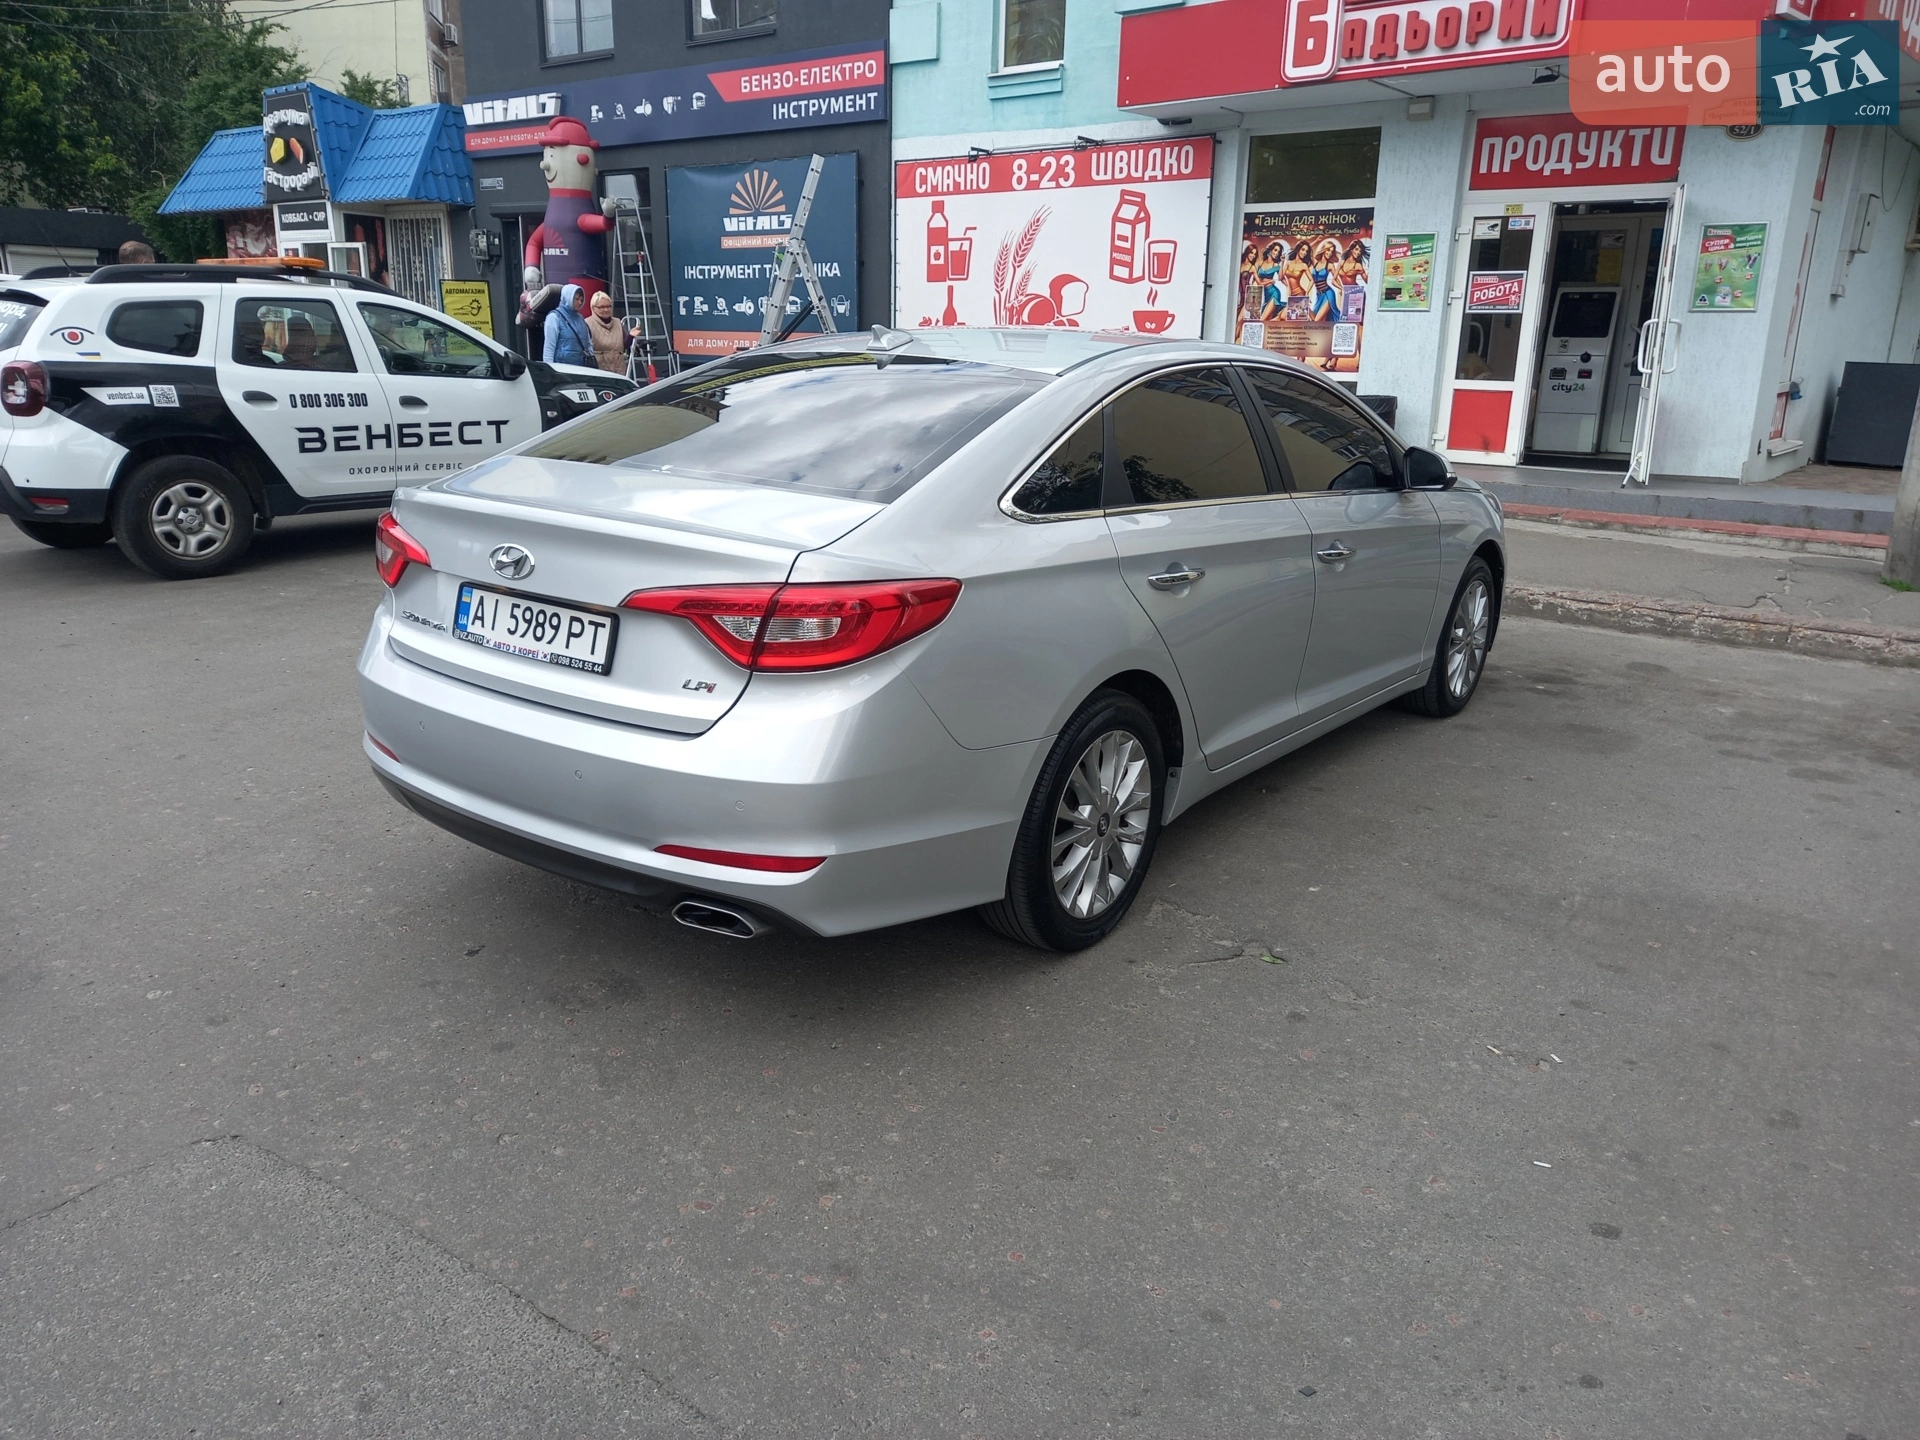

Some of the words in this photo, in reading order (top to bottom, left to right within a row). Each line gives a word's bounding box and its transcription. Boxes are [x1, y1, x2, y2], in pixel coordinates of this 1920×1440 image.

[741, 59, 877, 93] БЕНЗО-ЕЛЕКТРО
[773, 92, 878, 120] ІНСТРУМЕНТ
[1733, 126, 1755, 137] 52/1
[1479, 127, 1676, 176] ПРОДУКТИ
[915, 161, 990, 193] СМАЧНО
[1011, 154, 1076, 190] 8-23
[1090, 144, 1194, 181] ШВИДКО
[281, 212, 309, 223] КОВБАСА
[313, 211, 326, 221] СИР
[1257, 213, 1289, 228] Танці
[1291, 216, 1315, 227] для
[1318, 212, 1356, 224] жінок
[723, 236, 761, 247] ОФІЦІЙНИЙ
[1112, 251, 1131, 263] МОЛОКО
[684, 264, 761, 279] ІНСТРУМЕНТ
[1473, 282, 1519, 302] РОБОТА
[688, 339, 704, 347] ДЛЯ
[706, 339, 728, 348] ДОМУ
[106, 391, 145, 400] venbest.ua
[1551, 383, 1585, 393] city24
[289, 393, 298, 408] 0
[299, 393, 321, 408] 800
[323, 393, 345, 408] 306
[347, 393, 369, 407] 300
[577, 391, 589, 401] 211
[294, 420, 510, 454] ВЕНБЕСТ
[349, 462, 420, 475] ОХОРОННИЙ
[425, 462, 463, 472] СЕРВІС
[458, 613, 468, 625] UA
[507, 603, 562, 645] 5989
[493, 640, 511, 652] АВТО
[518, 647, 539, 659] КОРЕЇ
[557, 655, 570, 666] 098
[571, 657, 583, 669] 524
[584, 661, 593, 671] 55
[593, 663, 603, 673] 44
